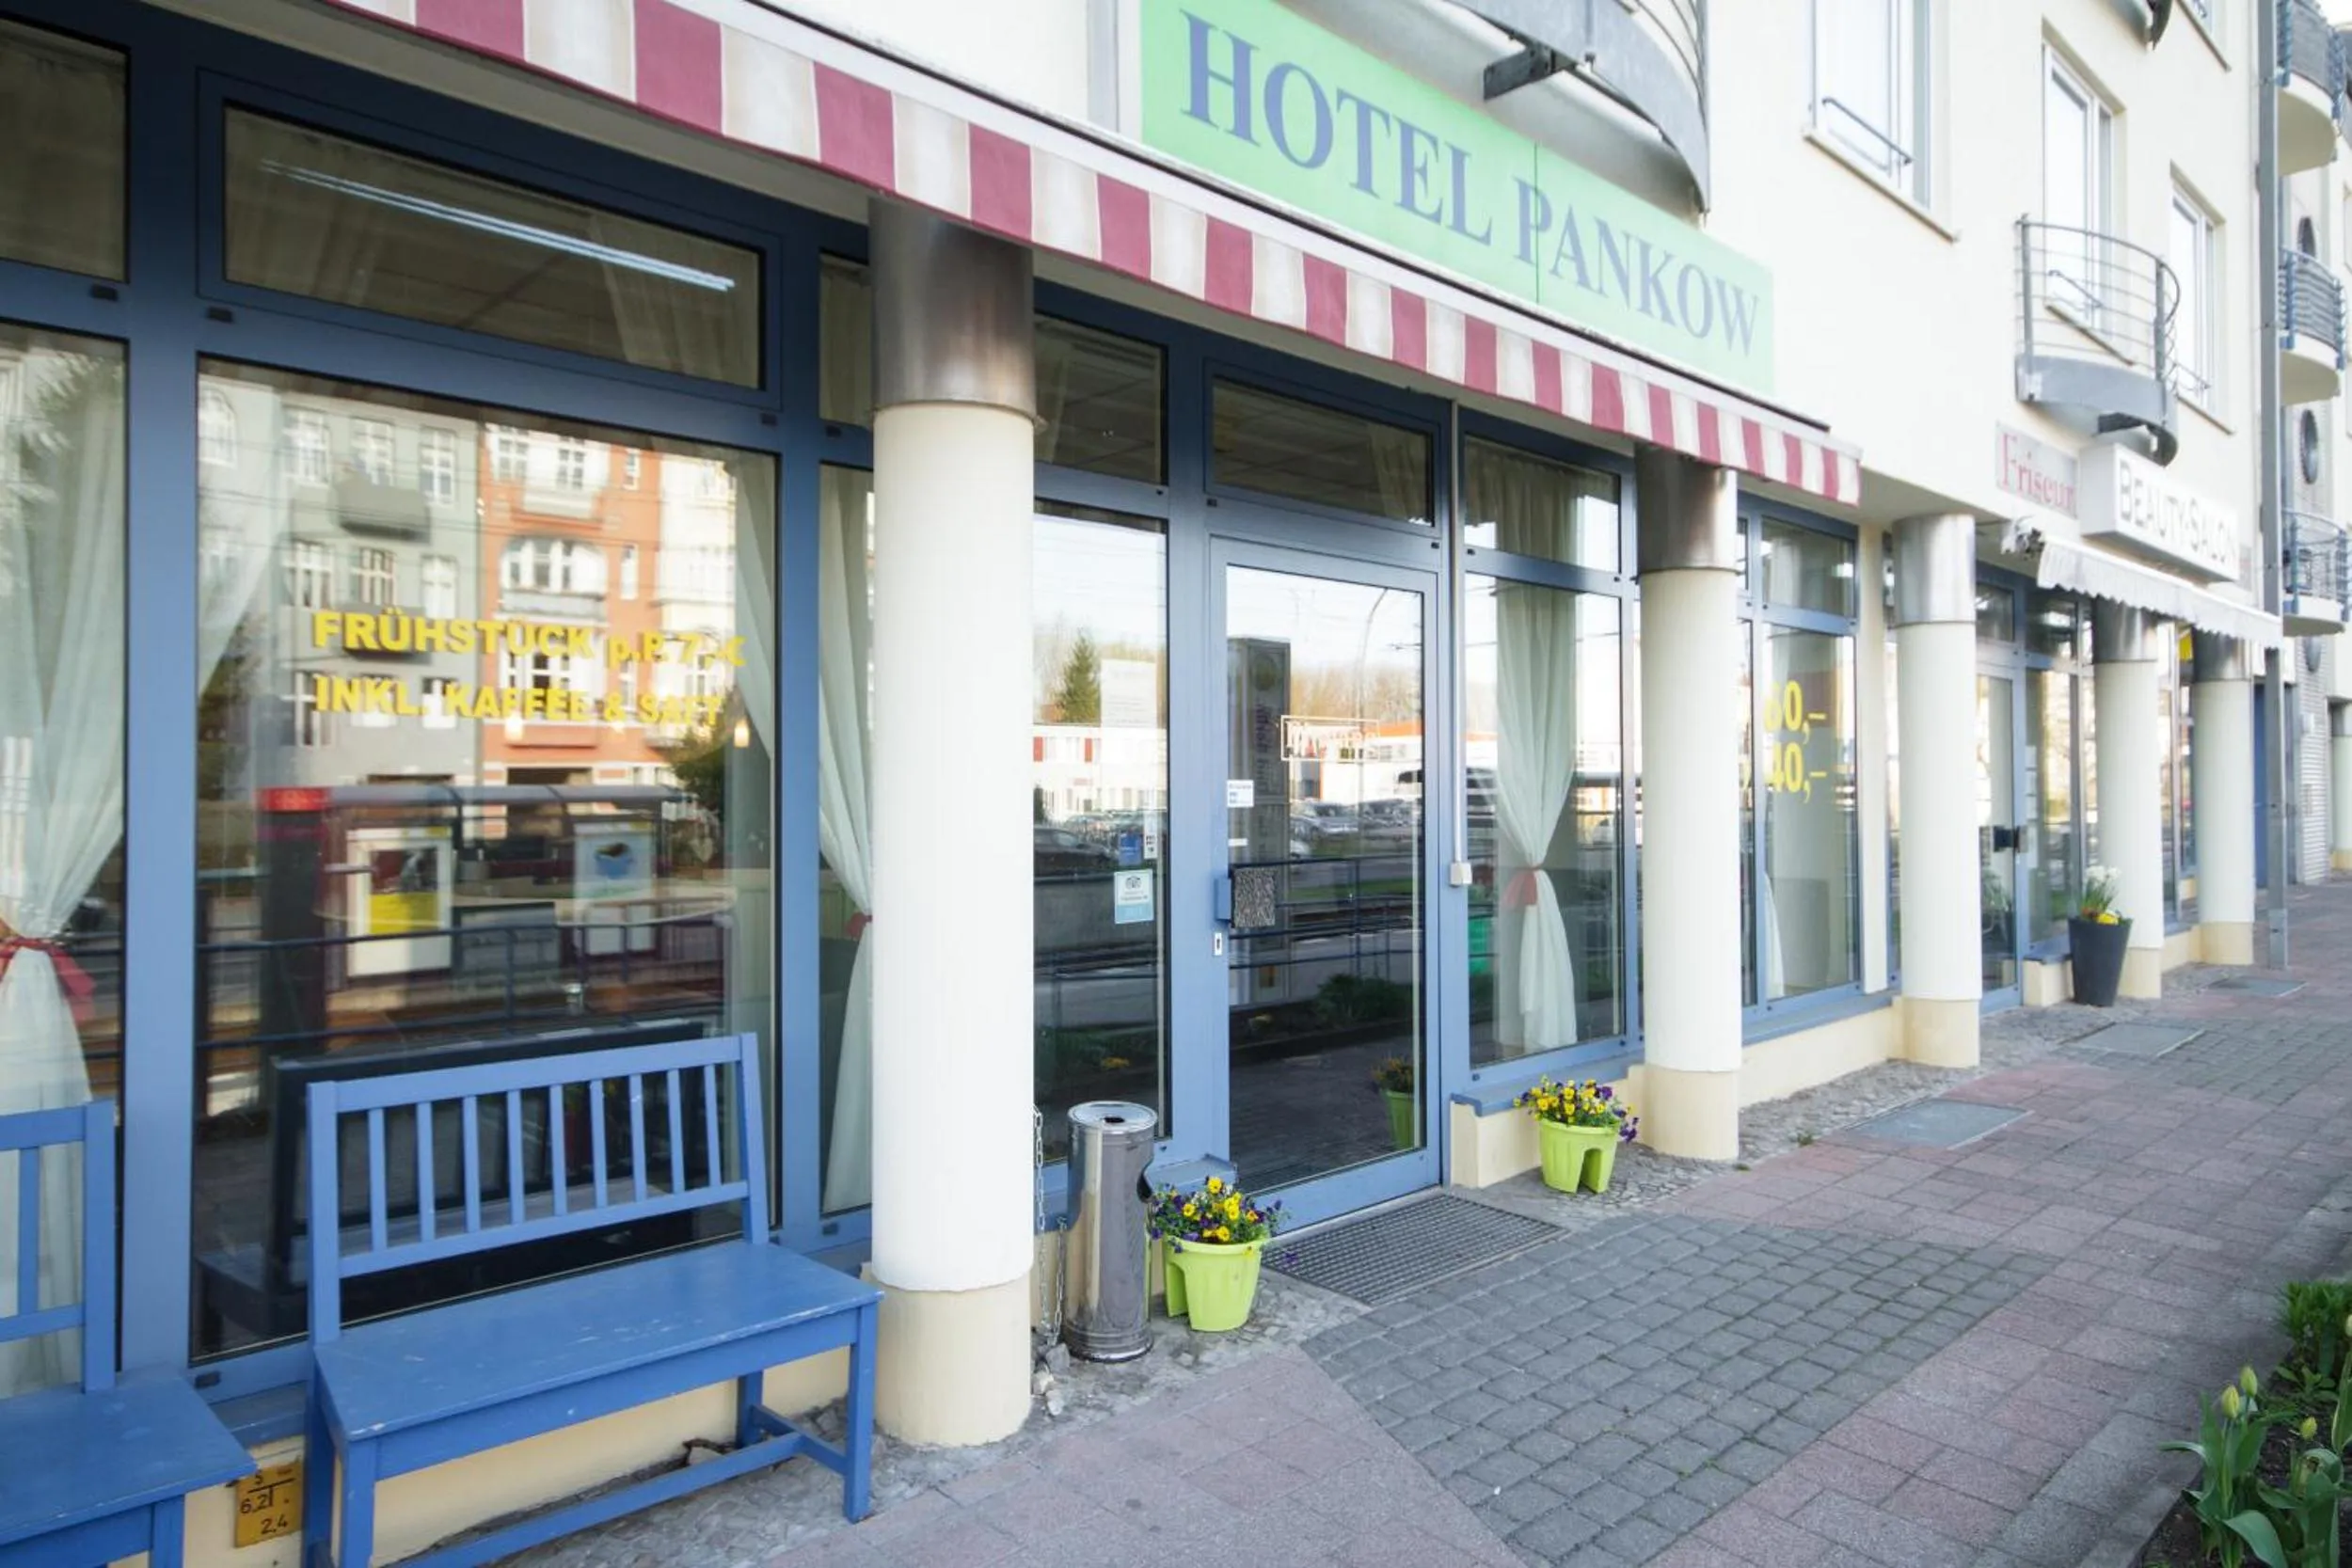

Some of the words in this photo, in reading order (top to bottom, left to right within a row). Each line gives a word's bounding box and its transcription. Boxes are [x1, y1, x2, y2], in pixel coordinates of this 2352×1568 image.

[1179, 8, 1493, 247] HOTEL
[1512, 174, 1759, 357] PANKOW
[2001, 432, 2074, 513] Friseur
[313, 607, 595, 659] FRÜHSTÜCK
[443, 681, 593, 721] KAFFEE
[602, 691, 627, 722] &
[638, 693, 723, 728] SAFT
